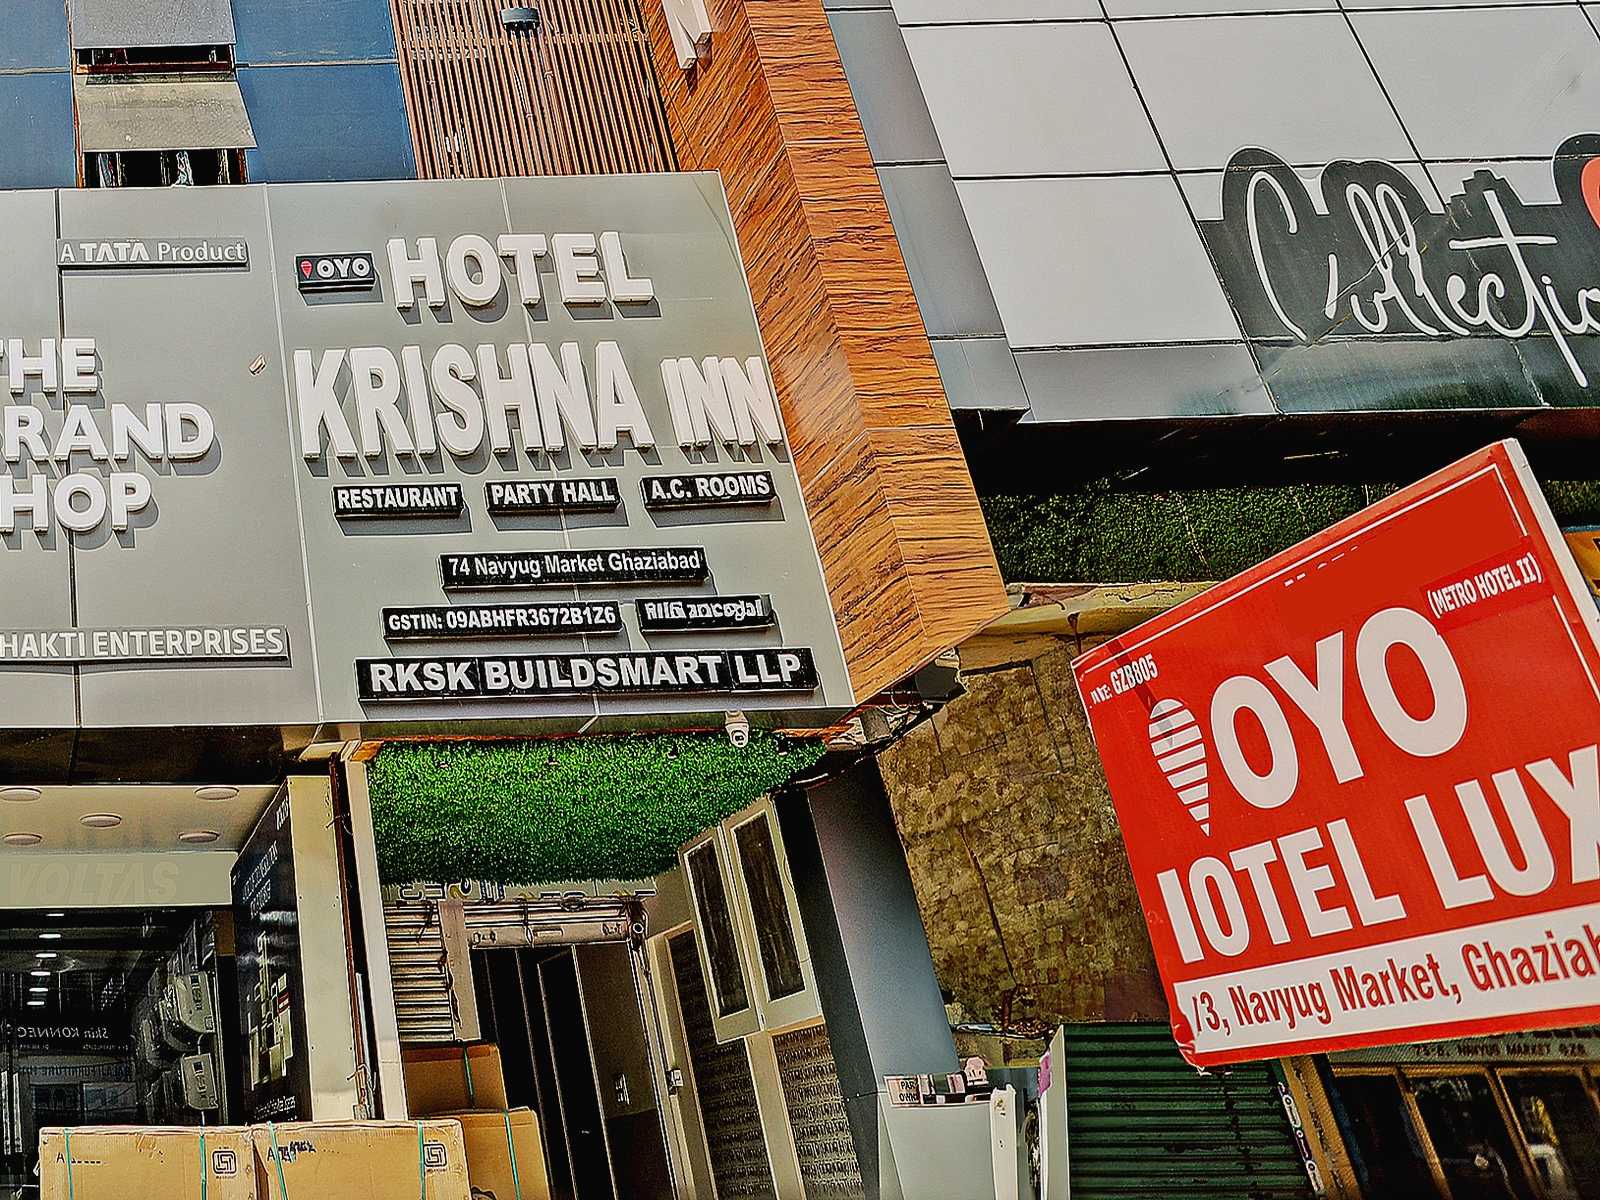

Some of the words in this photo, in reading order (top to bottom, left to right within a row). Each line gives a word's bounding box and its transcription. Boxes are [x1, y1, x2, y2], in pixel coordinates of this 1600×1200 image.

[59, 243, 73, 262] A
[80, 241, 150, 262] TATA
[157, 241, 246, 262] Product
[315, 256, 372, 279] OYO
[387, 231, 655, 308] HOTEL
[293, 341, 656, 459] KRISHNA
[660, 356, 784, 448] INN
[337, 486, 459, 510] RESTAURANT
[490, 483, 555, 506] PARTY
[561, 480, 616, 503] HALL
[650, 478, 692, 500] A.C.
[697, 473, 771, 498] ROOMS
[448, 557, 470, 577] 74
[474, 555, 543, 582] Navyug
[544, 553, 605, 574] Market
[607, 550, 701, 574] Ghaziabad
[1426, 579, 1478, 619] (METRO
[1473, 563, 1521, 599] HOTEL
[388, 613, 443, 631] GSTIN:
[445, 606, 617, 630] 09ABHFR3672B1Z6
[93, 627, 285, 657] ENTERPRISES
[369, 659, 476, 693] RKSK
[483, 655, 723, 690] BUILDSMART
[731, 653, 802, 685] LLP
[1110, 653, 1159, 695] GZB805
[1209, 605, 1469, 811] OYO
[1227, 979, 1333, 1029] Navyug
[1330, 951, 1463, 1011] Market,
